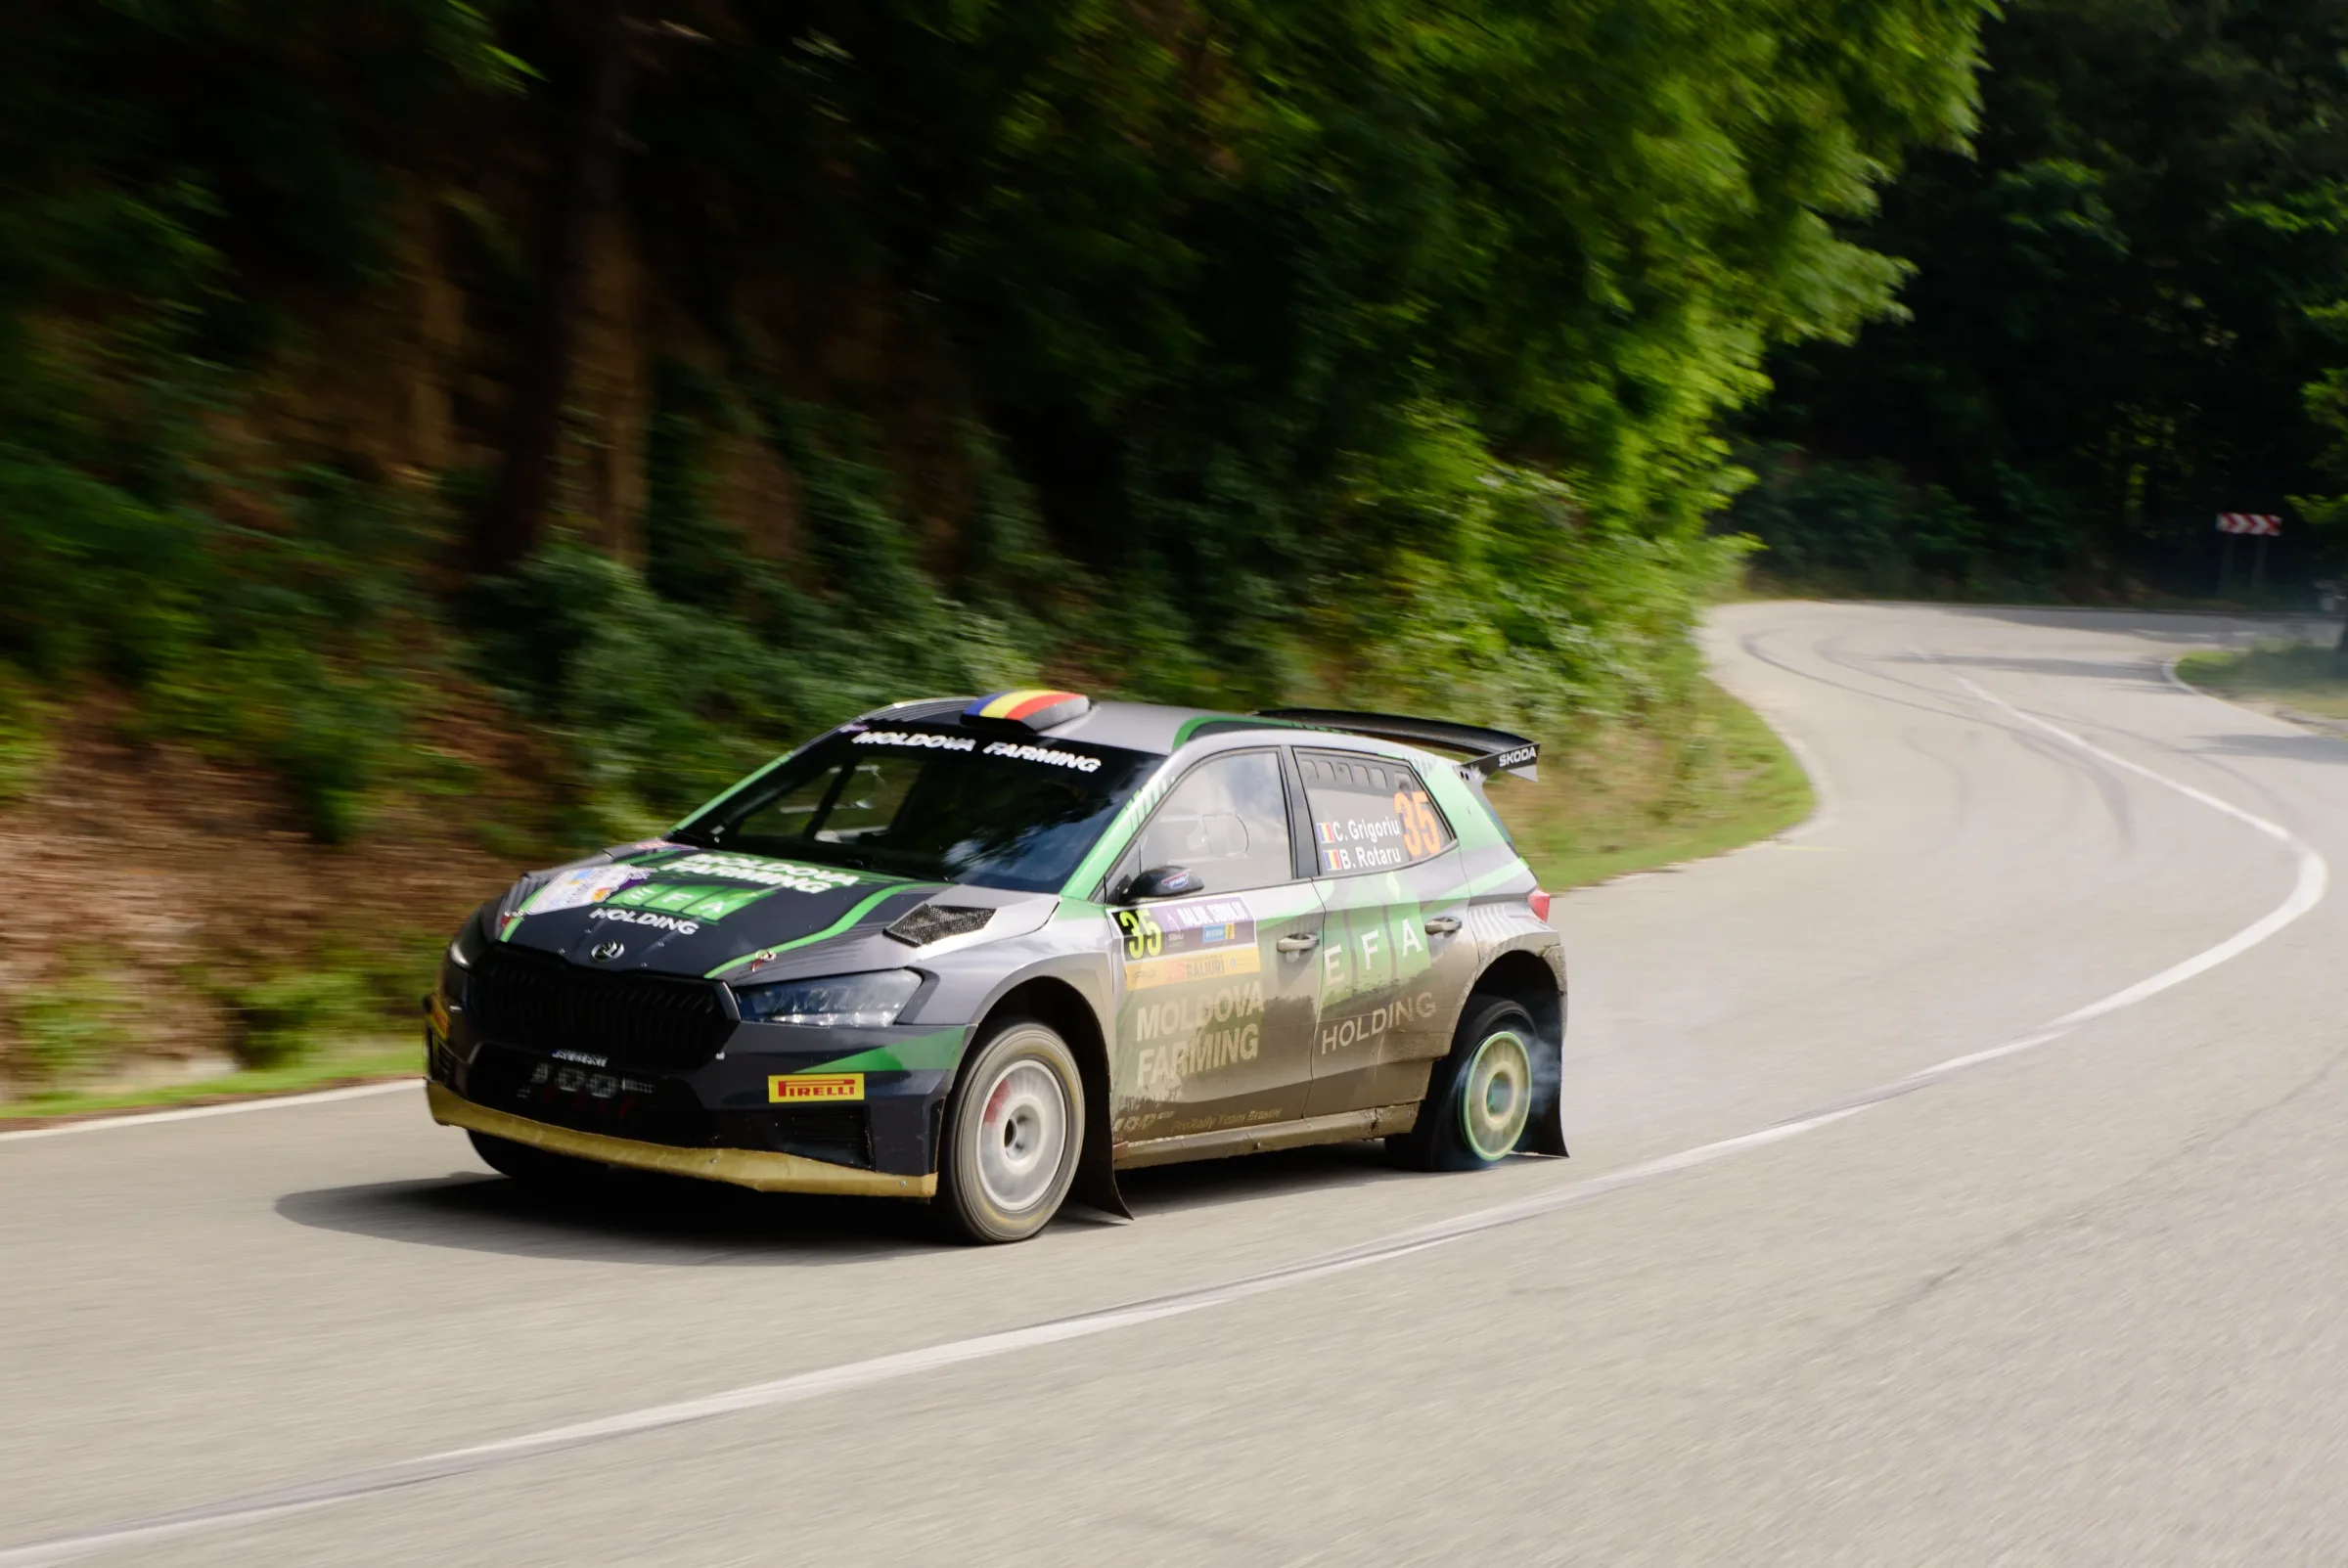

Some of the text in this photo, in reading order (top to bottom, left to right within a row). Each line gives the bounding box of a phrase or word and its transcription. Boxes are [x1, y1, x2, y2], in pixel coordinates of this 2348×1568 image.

[851, 732, 1102, 773] MOLDOVA FARMING
[1332, 816, 1401, 842] C. Grigoriu
[1393, 790, 1441, 857] 35
[1339, 845, 1402, 870] B. Rotaru
[589, 907, 700, 935] HOLDING
[1119, 907, 1162, 960] 35
[1136, 979, 1265, 1043] MOLDOVA
[1322, 991, 1437, 1055] HOLDING
[1136, 1022, 1259, 1088] FARMING
[778, 1079, 856, 1098] PIRELLI
